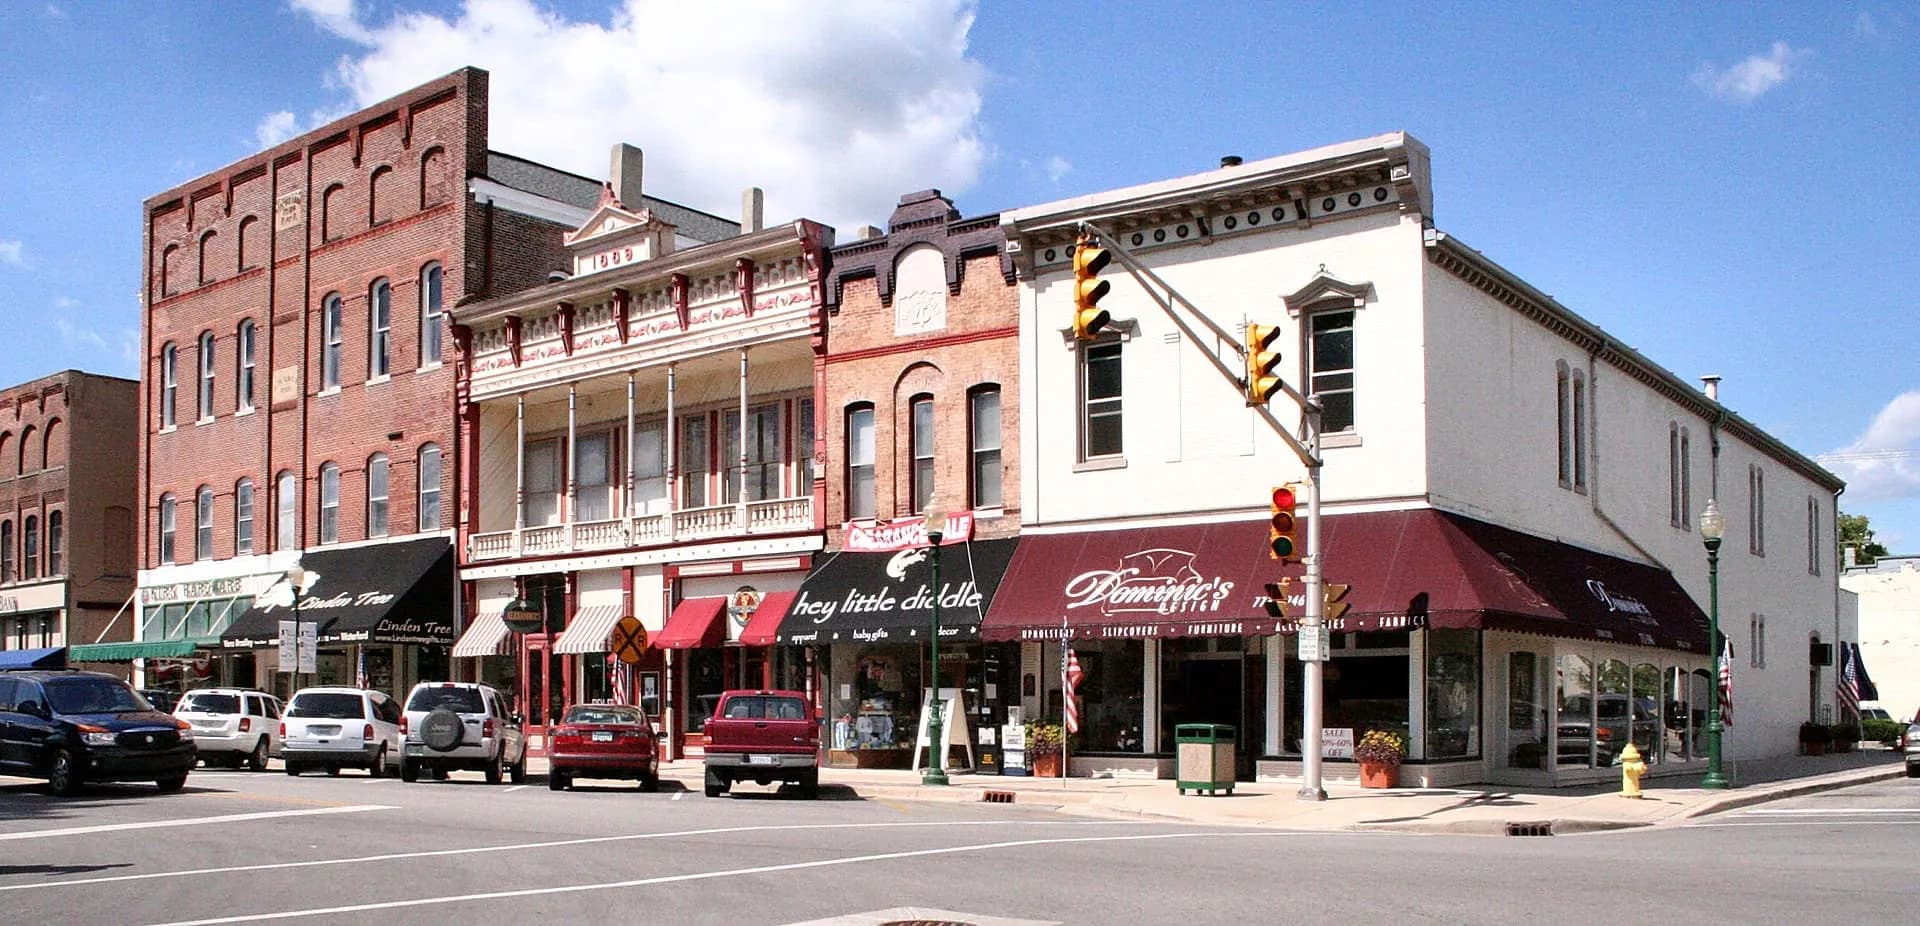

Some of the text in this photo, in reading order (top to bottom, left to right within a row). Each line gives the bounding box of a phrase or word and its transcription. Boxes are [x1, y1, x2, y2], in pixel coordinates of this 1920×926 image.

[943, 516, 969, 541] ALE
[1065, 567, 1235, 609] Dominic's
[291, 590, 395, 611] Linden Tree
[792, 590, 838, 624] hey
[840, 585, 897, 613] little
[1158, 599, 1221, 615] DESIGN
[376, 618, 452, 634] Linden Tree
[853, 629, 872, 642] baby
[871, 627, 889, 642] gifts
[1022, 628, 1075, 639] UPHOLSTERY
[1102, 625, 1158, 637] SLIPCOVERS
[1188, 623, 1243, 635] FURNITURE
[1379, 615, 1425, 628] FABRICS
